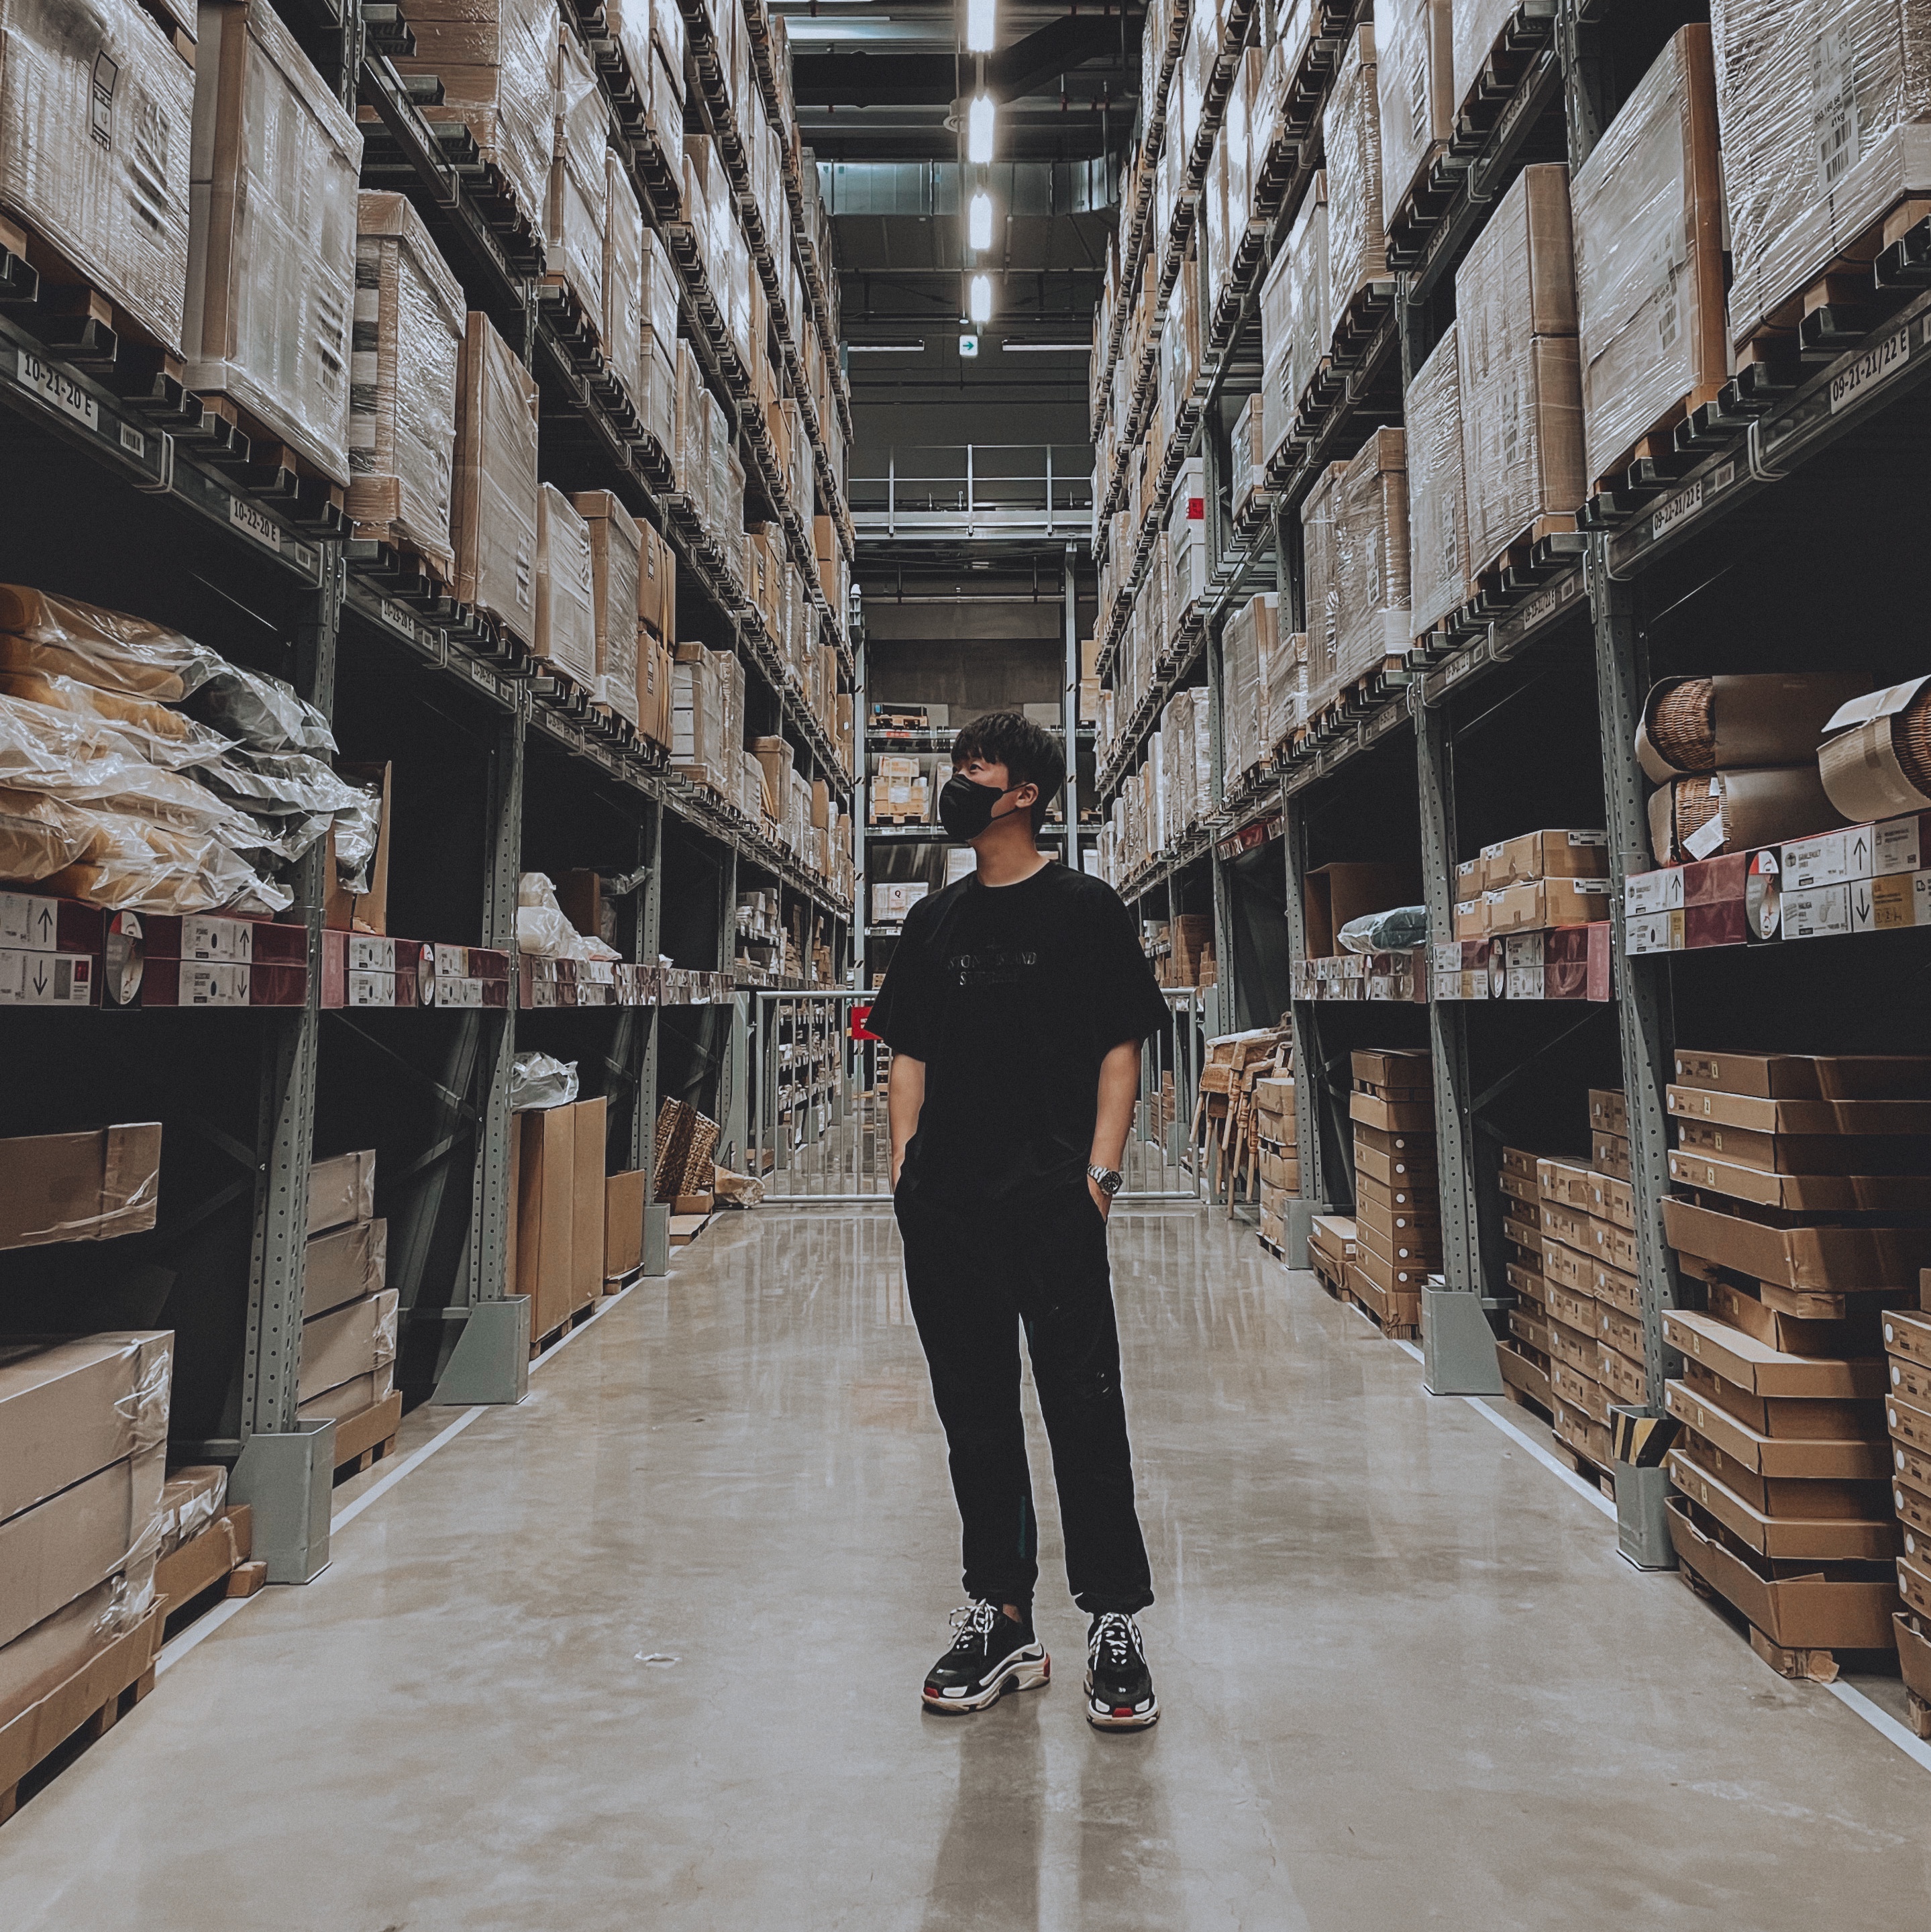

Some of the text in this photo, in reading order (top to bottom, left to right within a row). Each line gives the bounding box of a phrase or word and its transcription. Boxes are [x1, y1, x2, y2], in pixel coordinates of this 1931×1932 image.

[25, 353, 92, 418] 10-21-20 E
[1833, 329, 1907, 402] 09-21-21/22 E
[1695, 483, 1700, 501] E
[234, 500, 276, 542] 10-22-20 E
[894, 890, 901, 899] Q
